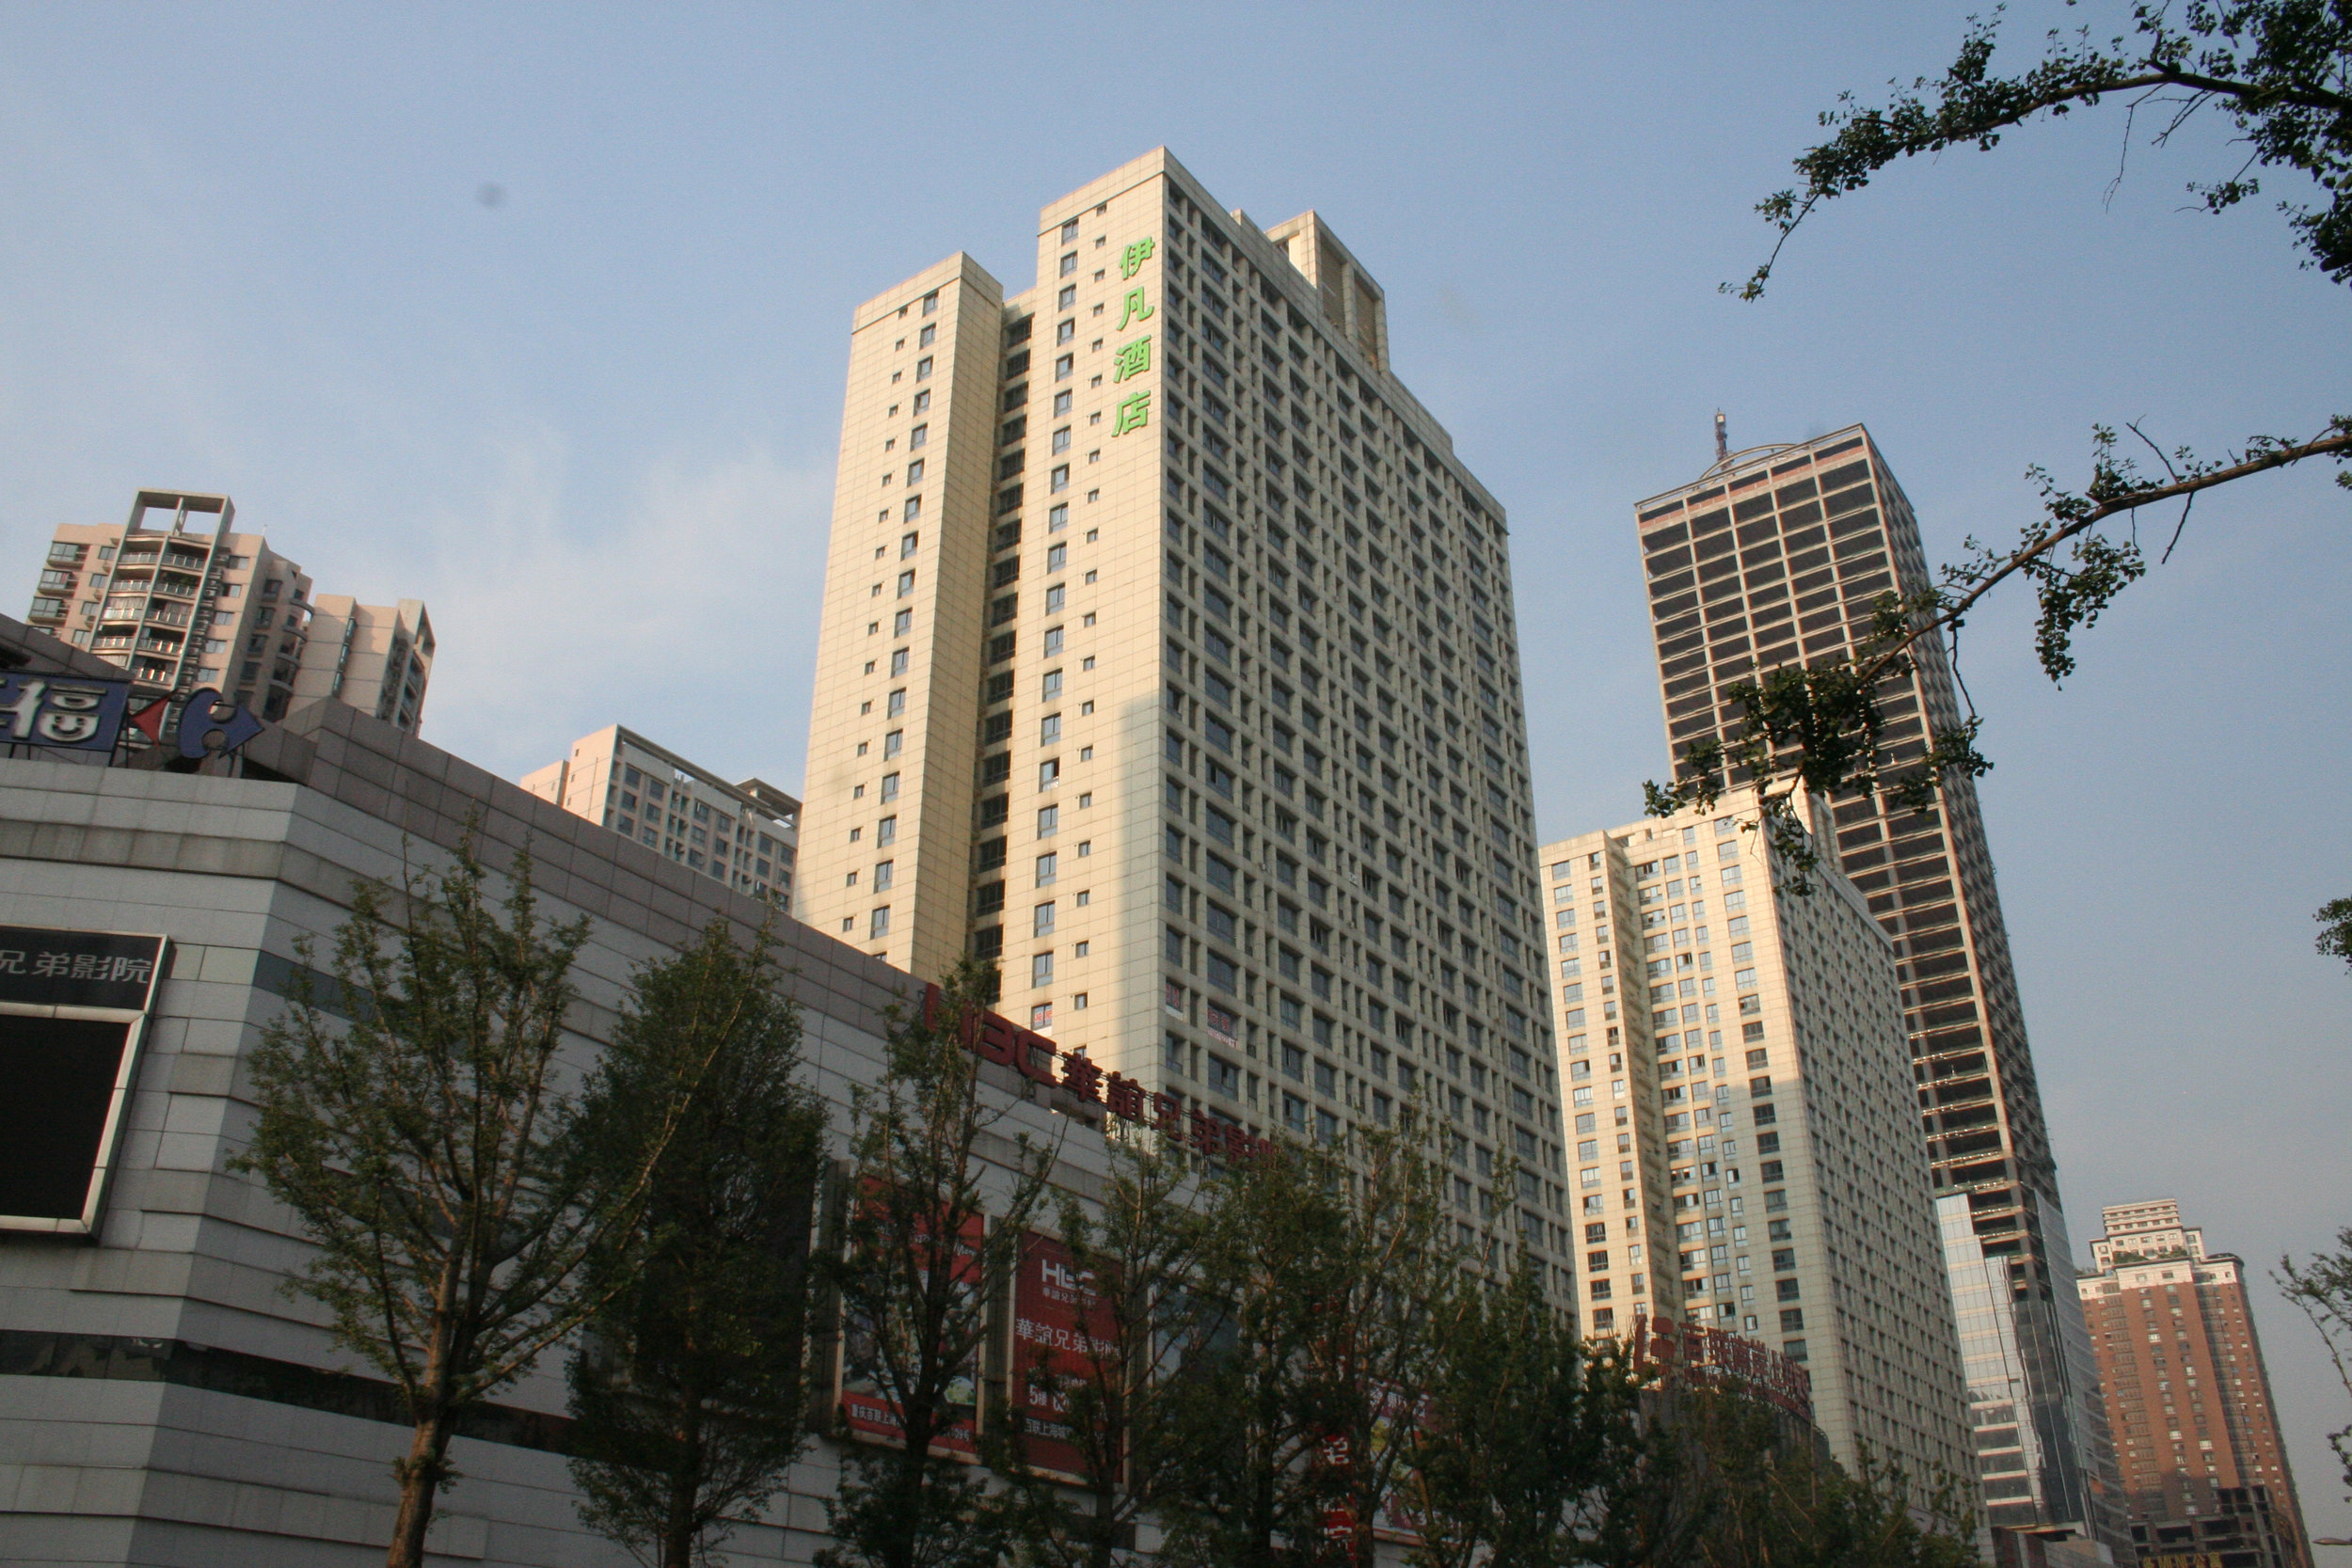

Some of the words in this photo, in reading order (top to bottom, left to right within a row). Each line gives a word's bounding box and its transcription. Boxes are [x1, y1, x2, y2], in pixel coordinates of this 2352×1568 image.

[1111, 236, 1155, 437] 伊凡酒店
[0, 949, 153, 985] 兄弟影院
